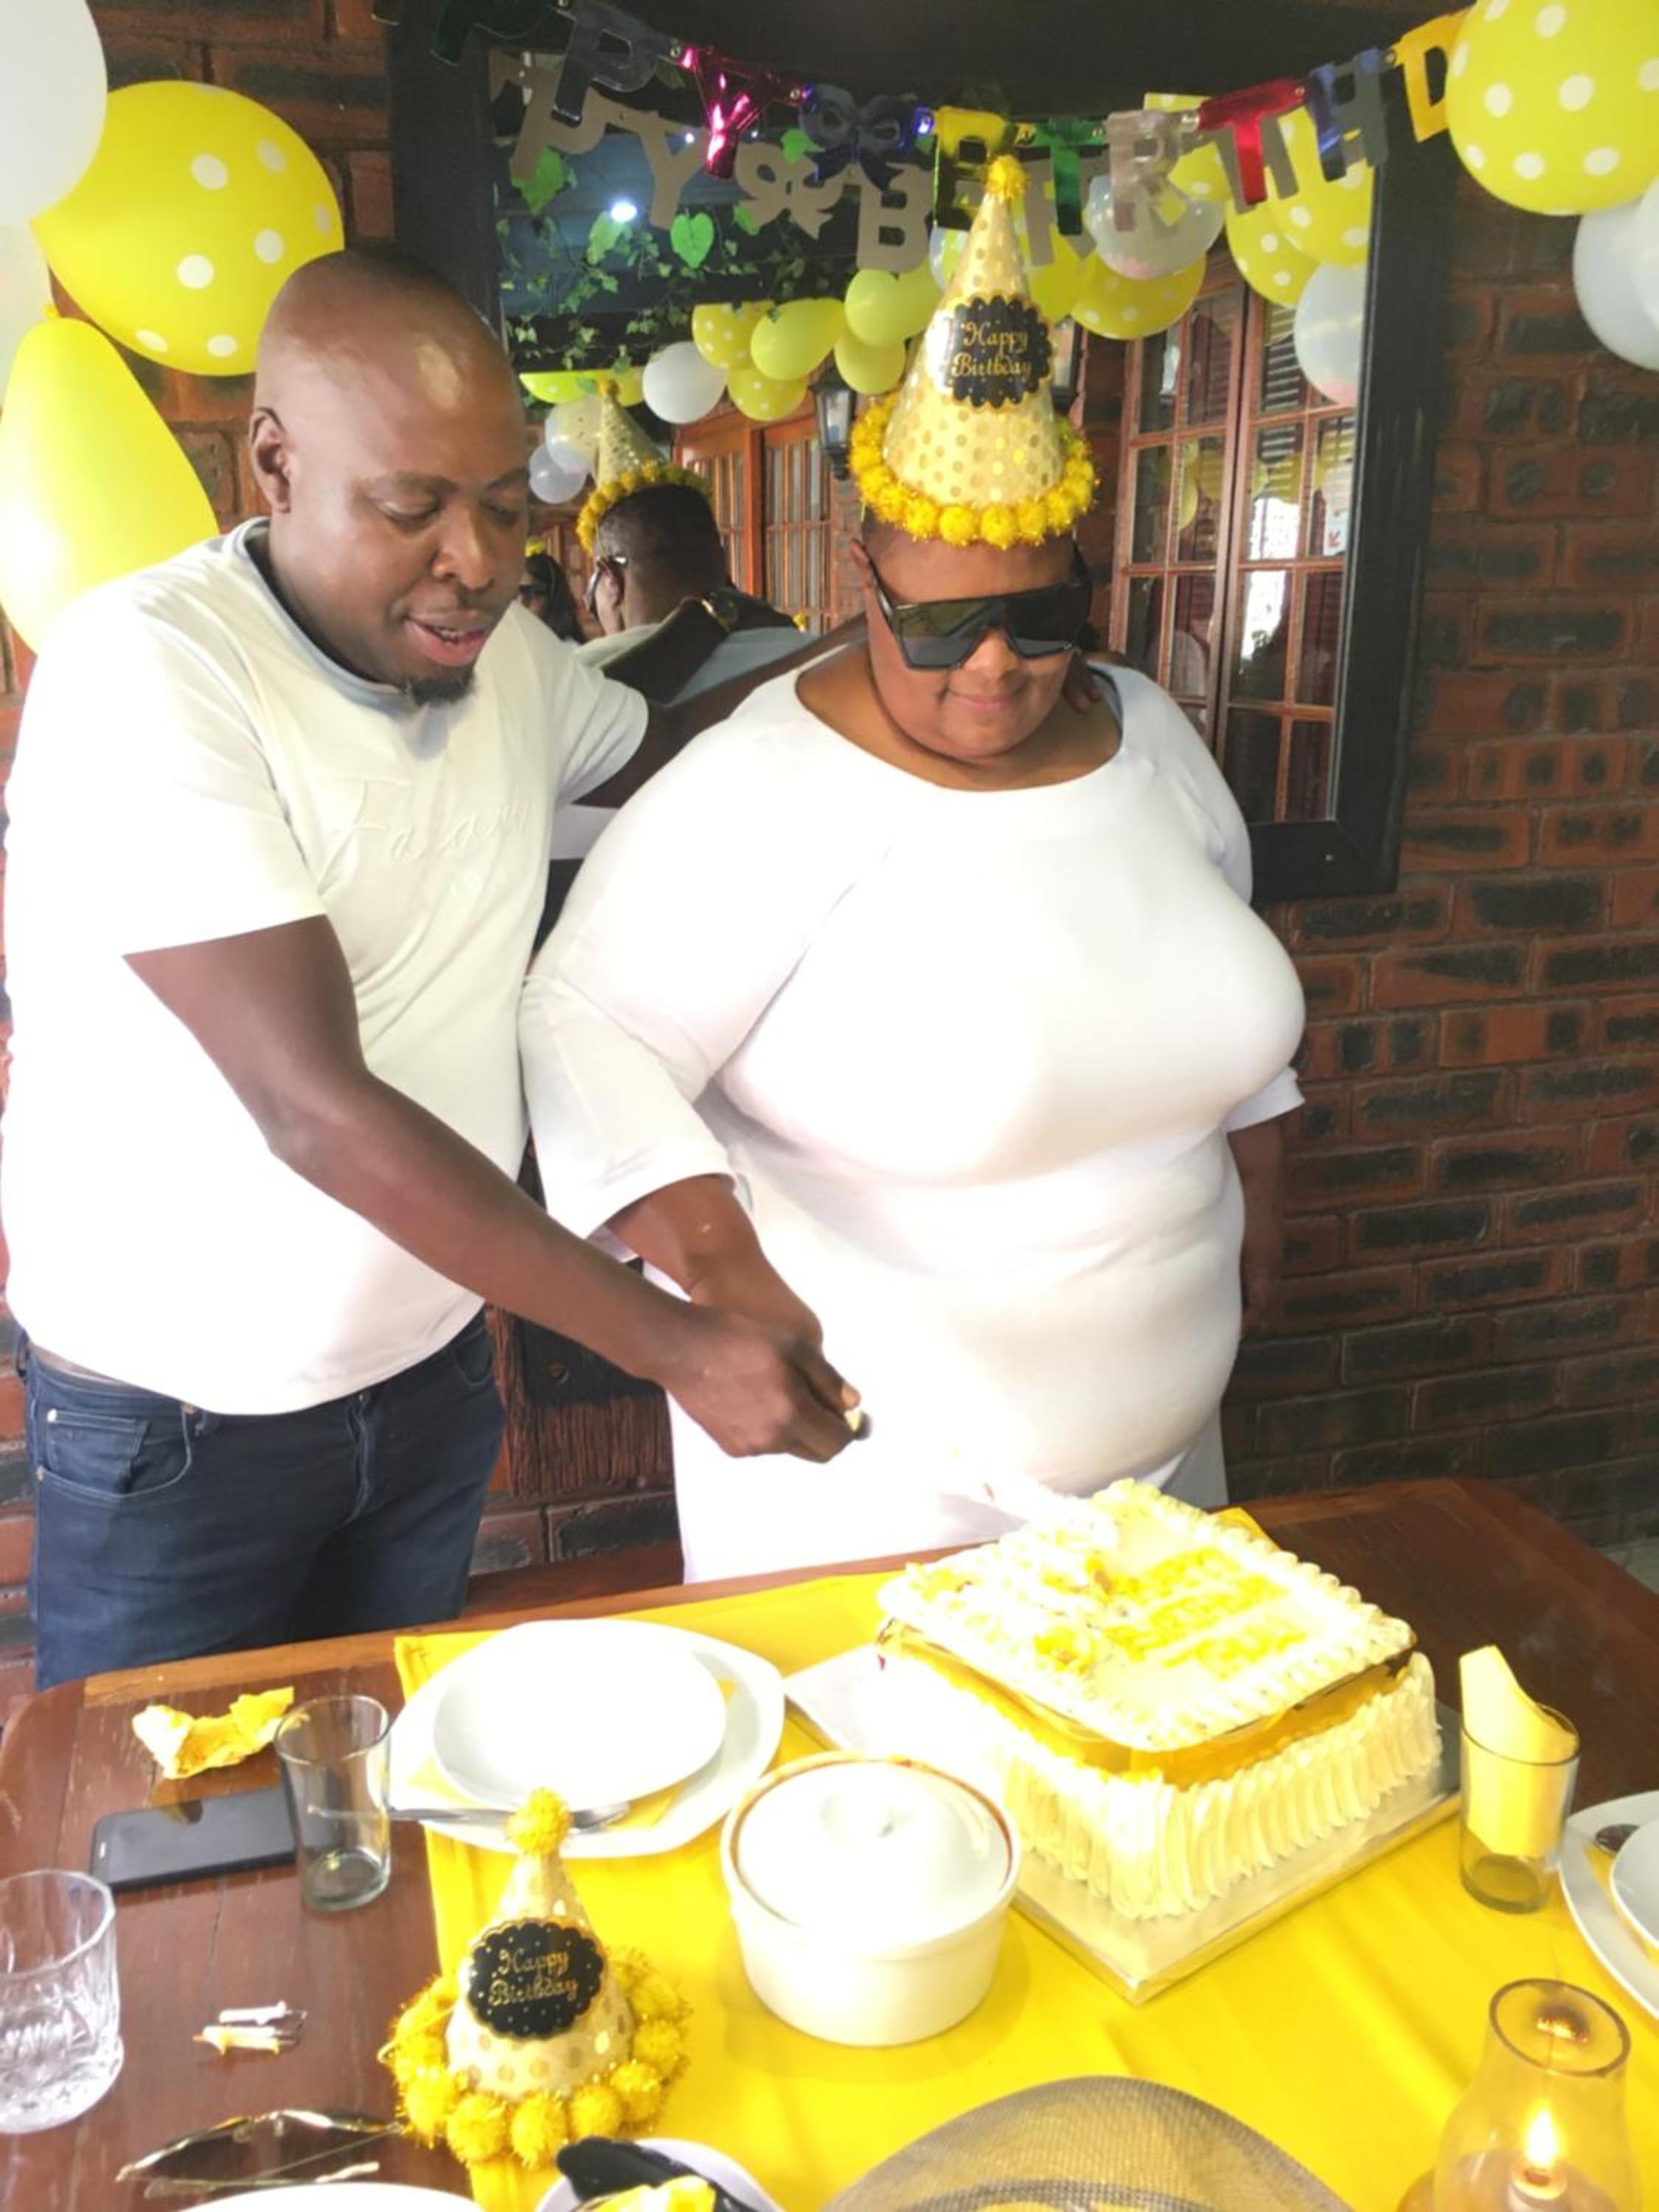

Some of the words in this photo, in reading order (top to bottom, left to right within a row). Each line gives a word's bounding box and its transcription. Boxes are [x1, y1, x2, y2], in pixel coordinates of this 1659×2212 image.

[961, 320, 1028, 355] Happy
[950, 353, 1032, 379] Birthday
[497, 1949, 568, 1979] Happy
[487, 1977, 579, 2006] Birthday
